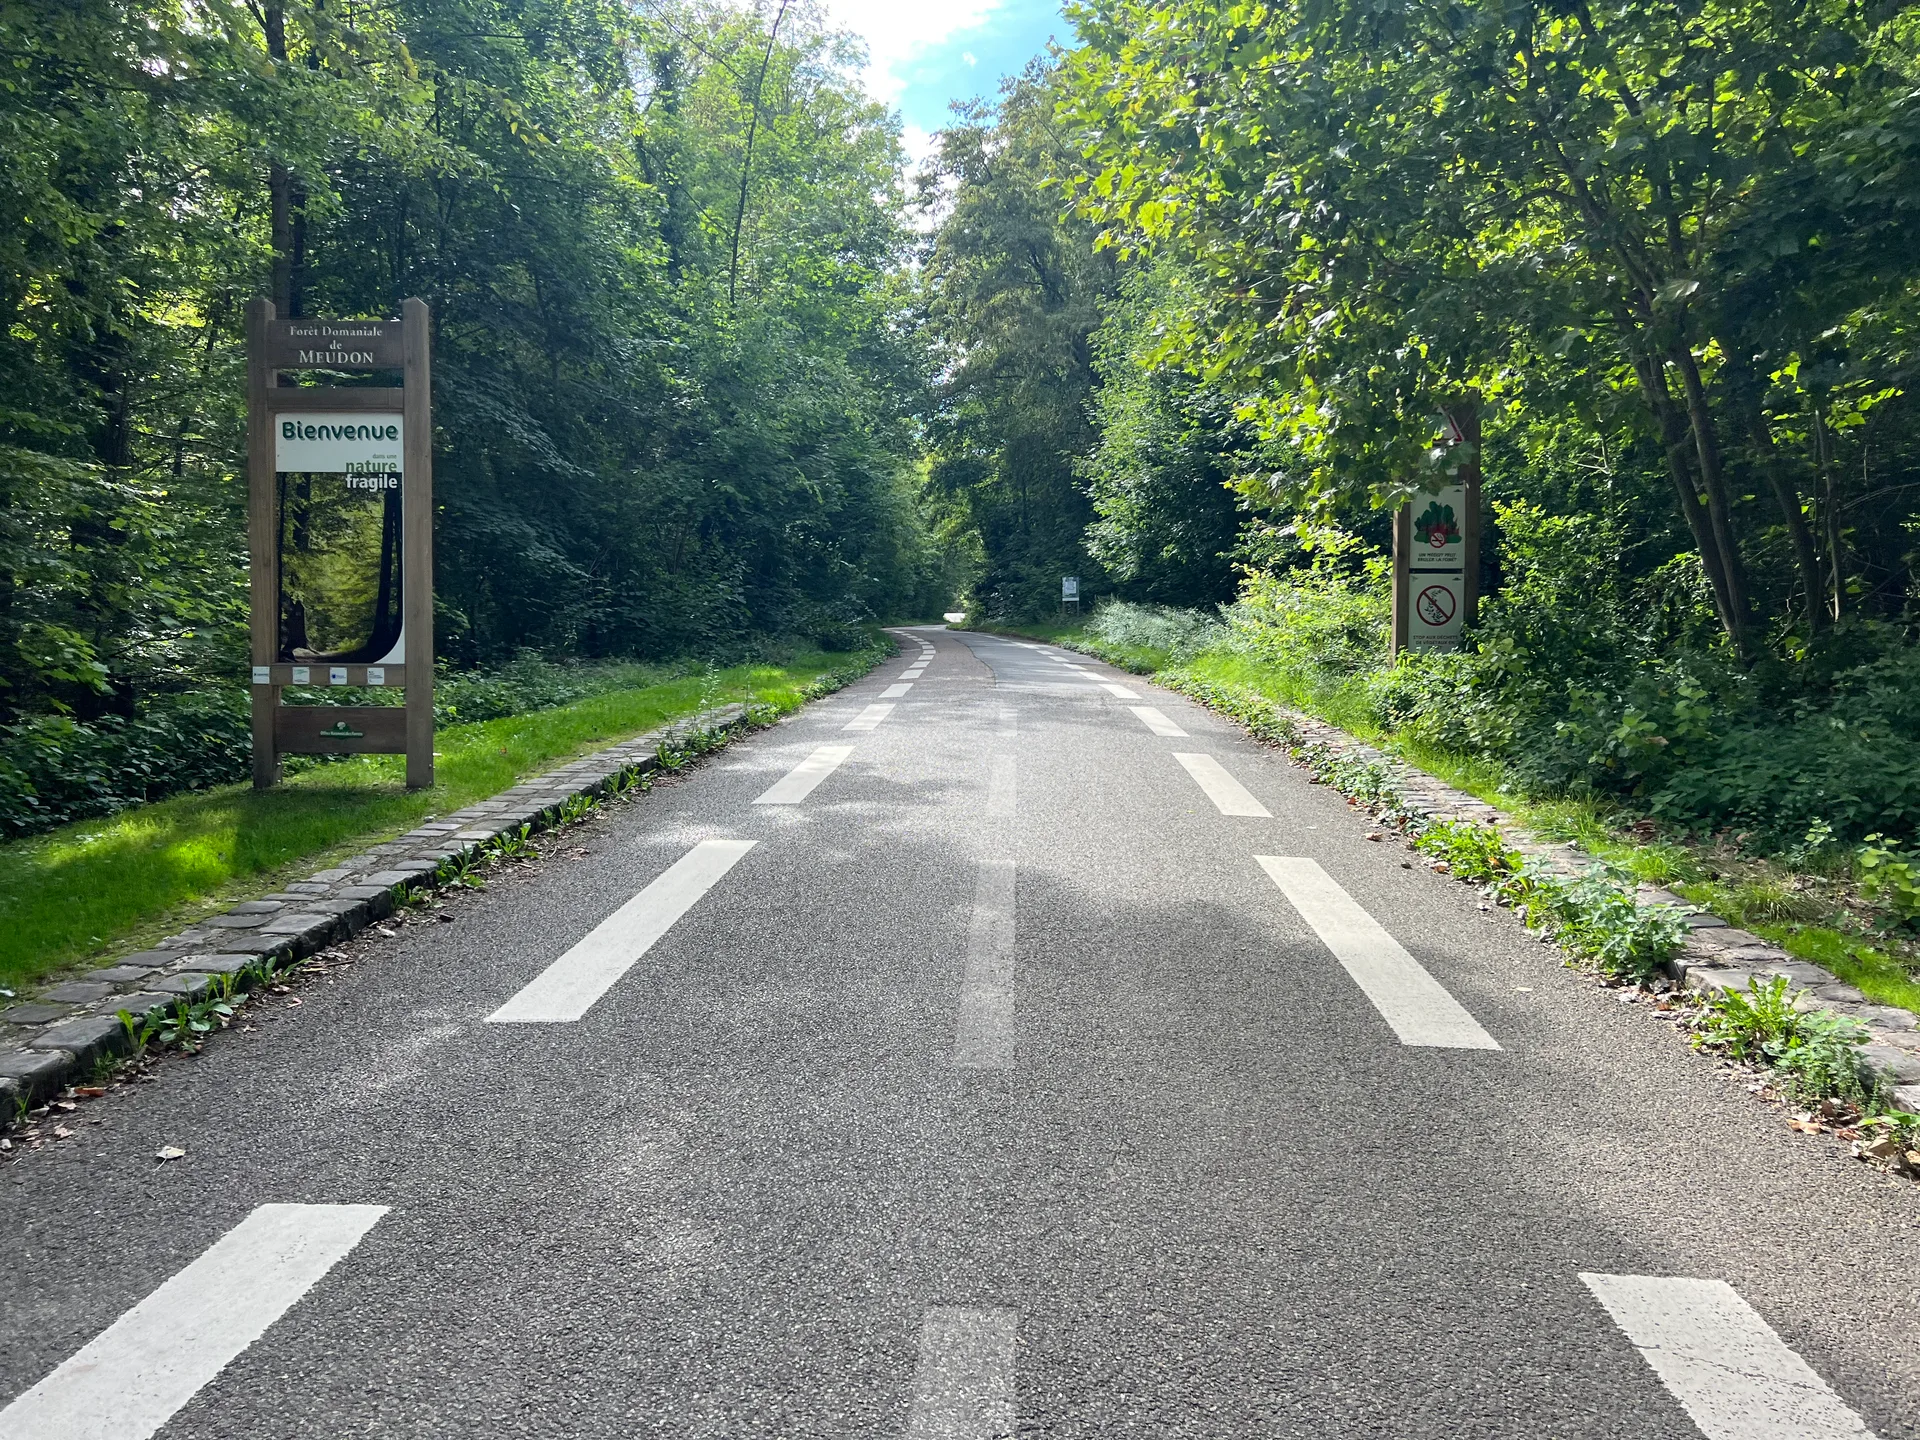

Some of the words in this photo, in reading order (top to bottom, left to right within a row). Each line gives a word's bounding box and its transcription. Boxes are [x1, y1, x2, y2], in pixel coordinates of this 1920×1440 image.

[290, 326, 318, 336] Forêt
[322, 326, 382, 336] Domaniale
[329, 340, 342, 350] de
[299, 350, 373, 363] MEUDON
[282, 420, 399, 441] Bienvenue
[345, 460, 397, 473] nature
[345, 474, 398, 492] fragile
